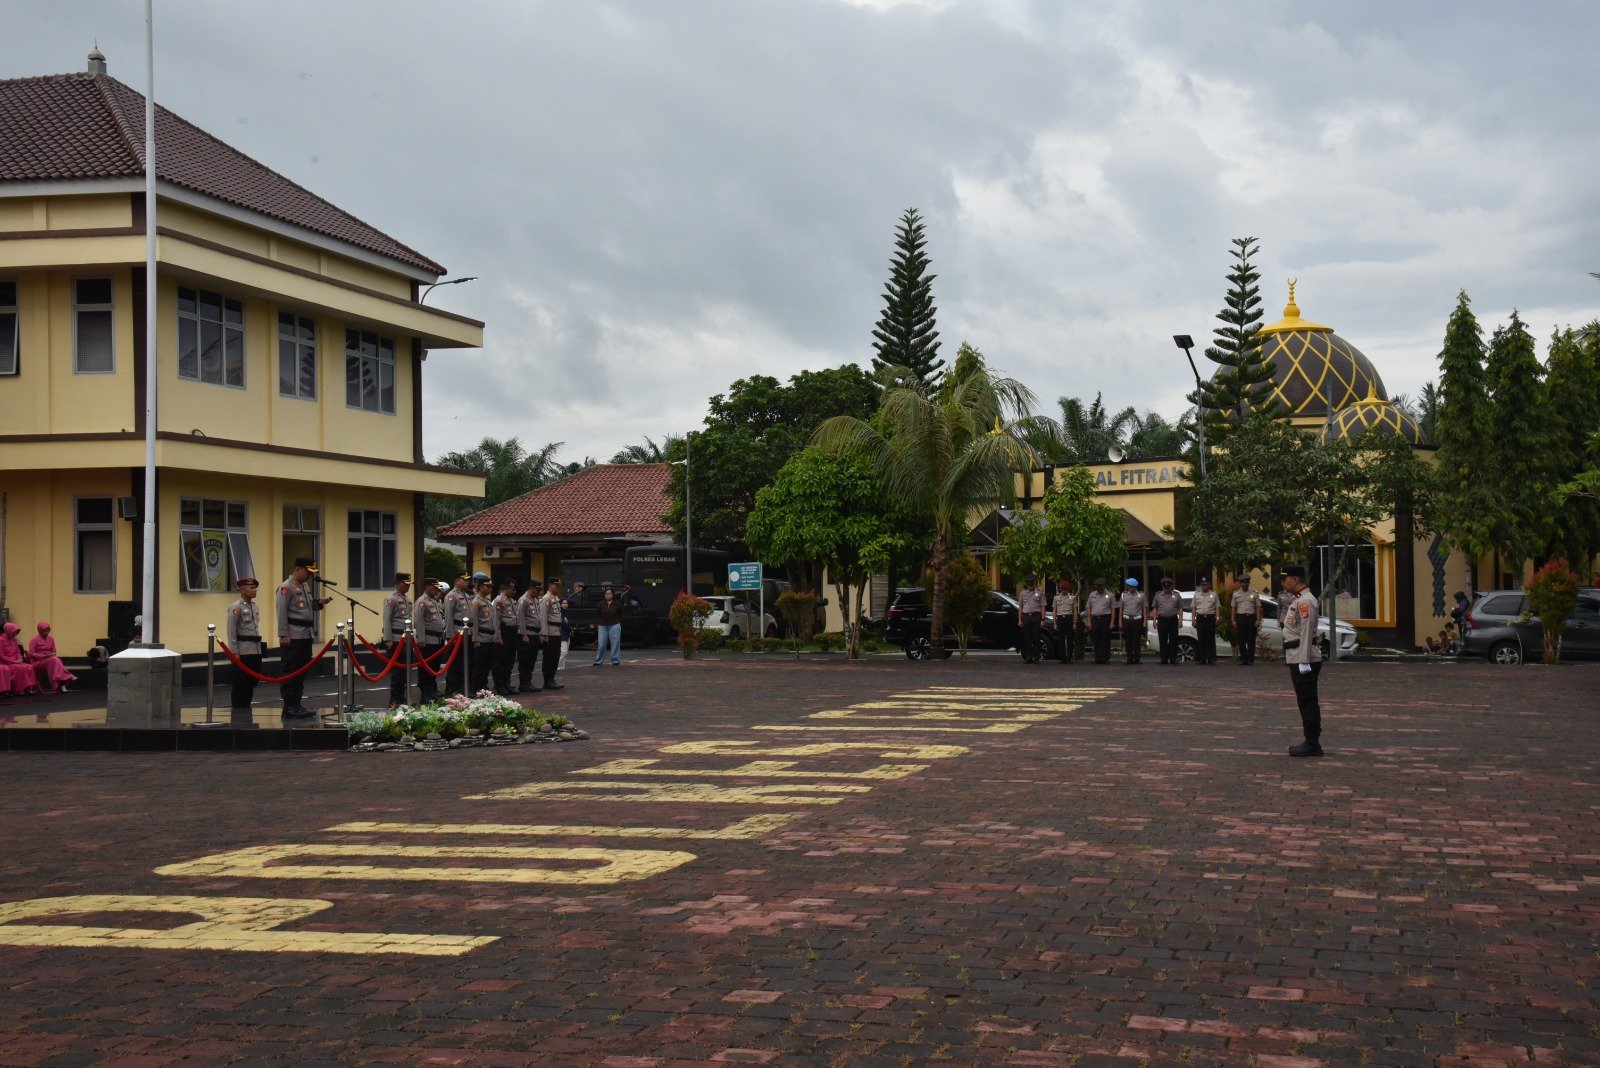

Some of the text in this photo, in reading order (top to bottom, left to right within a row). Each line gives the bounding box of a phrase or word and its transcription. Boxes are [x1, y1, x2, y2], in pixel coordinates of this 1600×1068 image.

[1096, 471, 1117, 486] AL
[0, 686, 1123, 957] POLRES LEBAK
